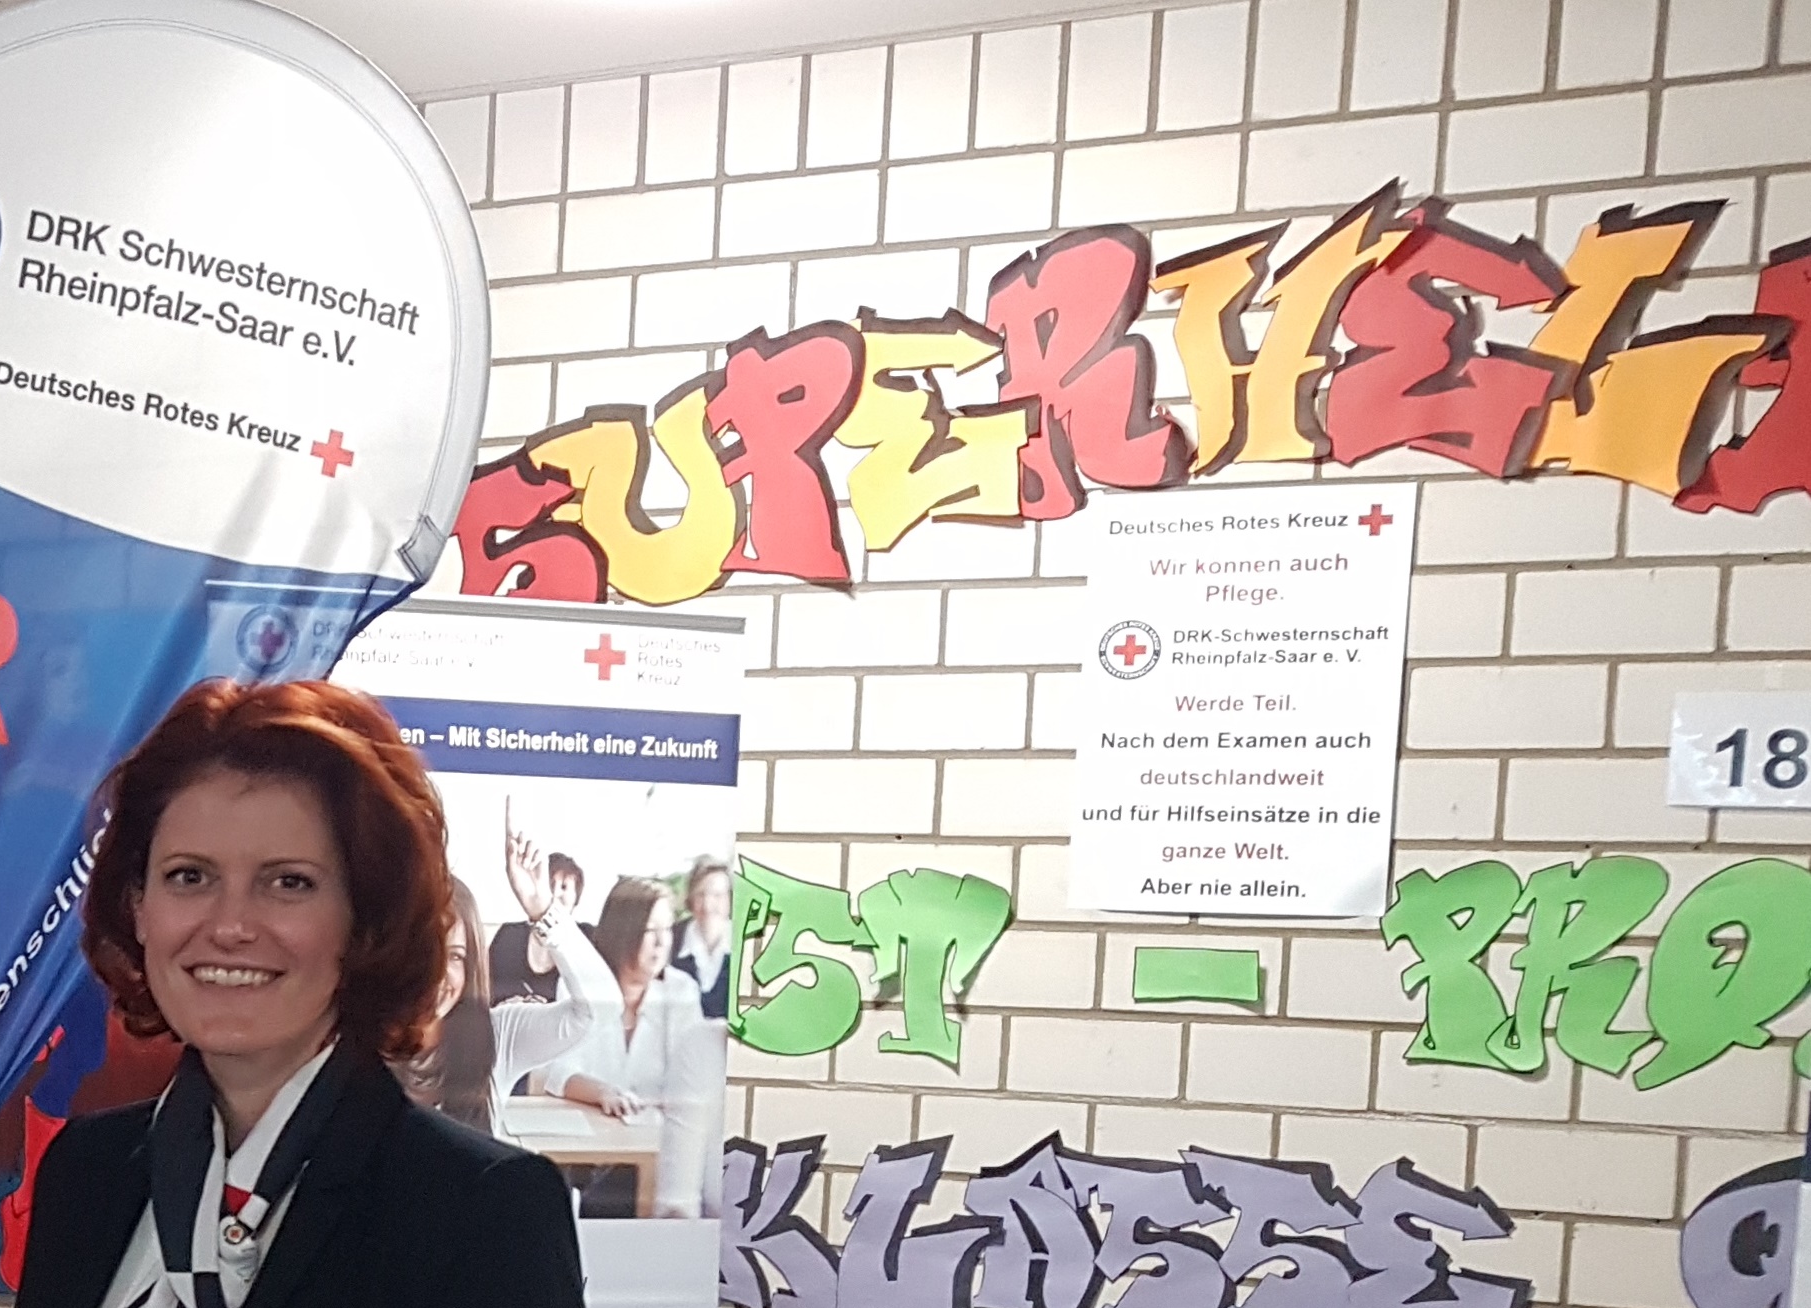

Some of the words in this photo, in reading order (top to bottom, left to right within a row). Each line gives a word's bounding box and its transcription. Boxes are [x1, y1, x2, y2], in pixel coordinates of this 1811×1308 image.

[26, 210, 112, 257] DRK
[118, 229, 421, 336] Schwesternschaft
[18, 258, 294, 348] Rheinpfalz-Saar
[301, 328, 357, 366] e.V.
[142, 392, 220, 432] Rotes
[226, 413, 302, 453] Kreuz
[1109, 518, 1215, 535] Deutsches
[1221, 515, 1280, 531] Rotes
[1288, 513, 1349, 528] Kreuz
[1149, 558, 1187, 576] Wir
[1290, 553, 1349, 572] auch
[1205, 584, 1285, 606] Pflege.
[1173, 626, 1389, 644] DRK-Schwesternschaft
[1172, 649, 1318, 667] Rheinpfalz-Saar
[1175, 695, 1244, 712] Werde
[1253, 694, 1298, 712] Teil.
[449, 726, 481, 748] Mit
[485, 728, 589, 754] Sicherheit
[593, 737, 637, 756] eine
[641, 736, 718, 760] Zukunft
[1100, 732, 1156, 749] Nach
[1162, 732, 1210, 749] dem
[1217, 732, 1308, 749] Examen
[1315, 732, 1373, 749] auch
[1715, 728, 1809, 790] 18
[1140, 769, 1325, 787] deutschlandweit
[1082, 805, 1123, 822] und
[1130, 804, 1160, 822] für
[1167, 804, 1311, 824] Hilfseinsätze
[1319, 806, 1339, 824] in
[1346, 806, 1382, 825] die
[1162, 846, 1227, 863] ganze
[1234, 842, 1290, 861] Welt.
[1141, 878, 1193, 896] Aber
[1200, 879, 1233, 896] nie
[1240, 880, 1307, 899] allein.
